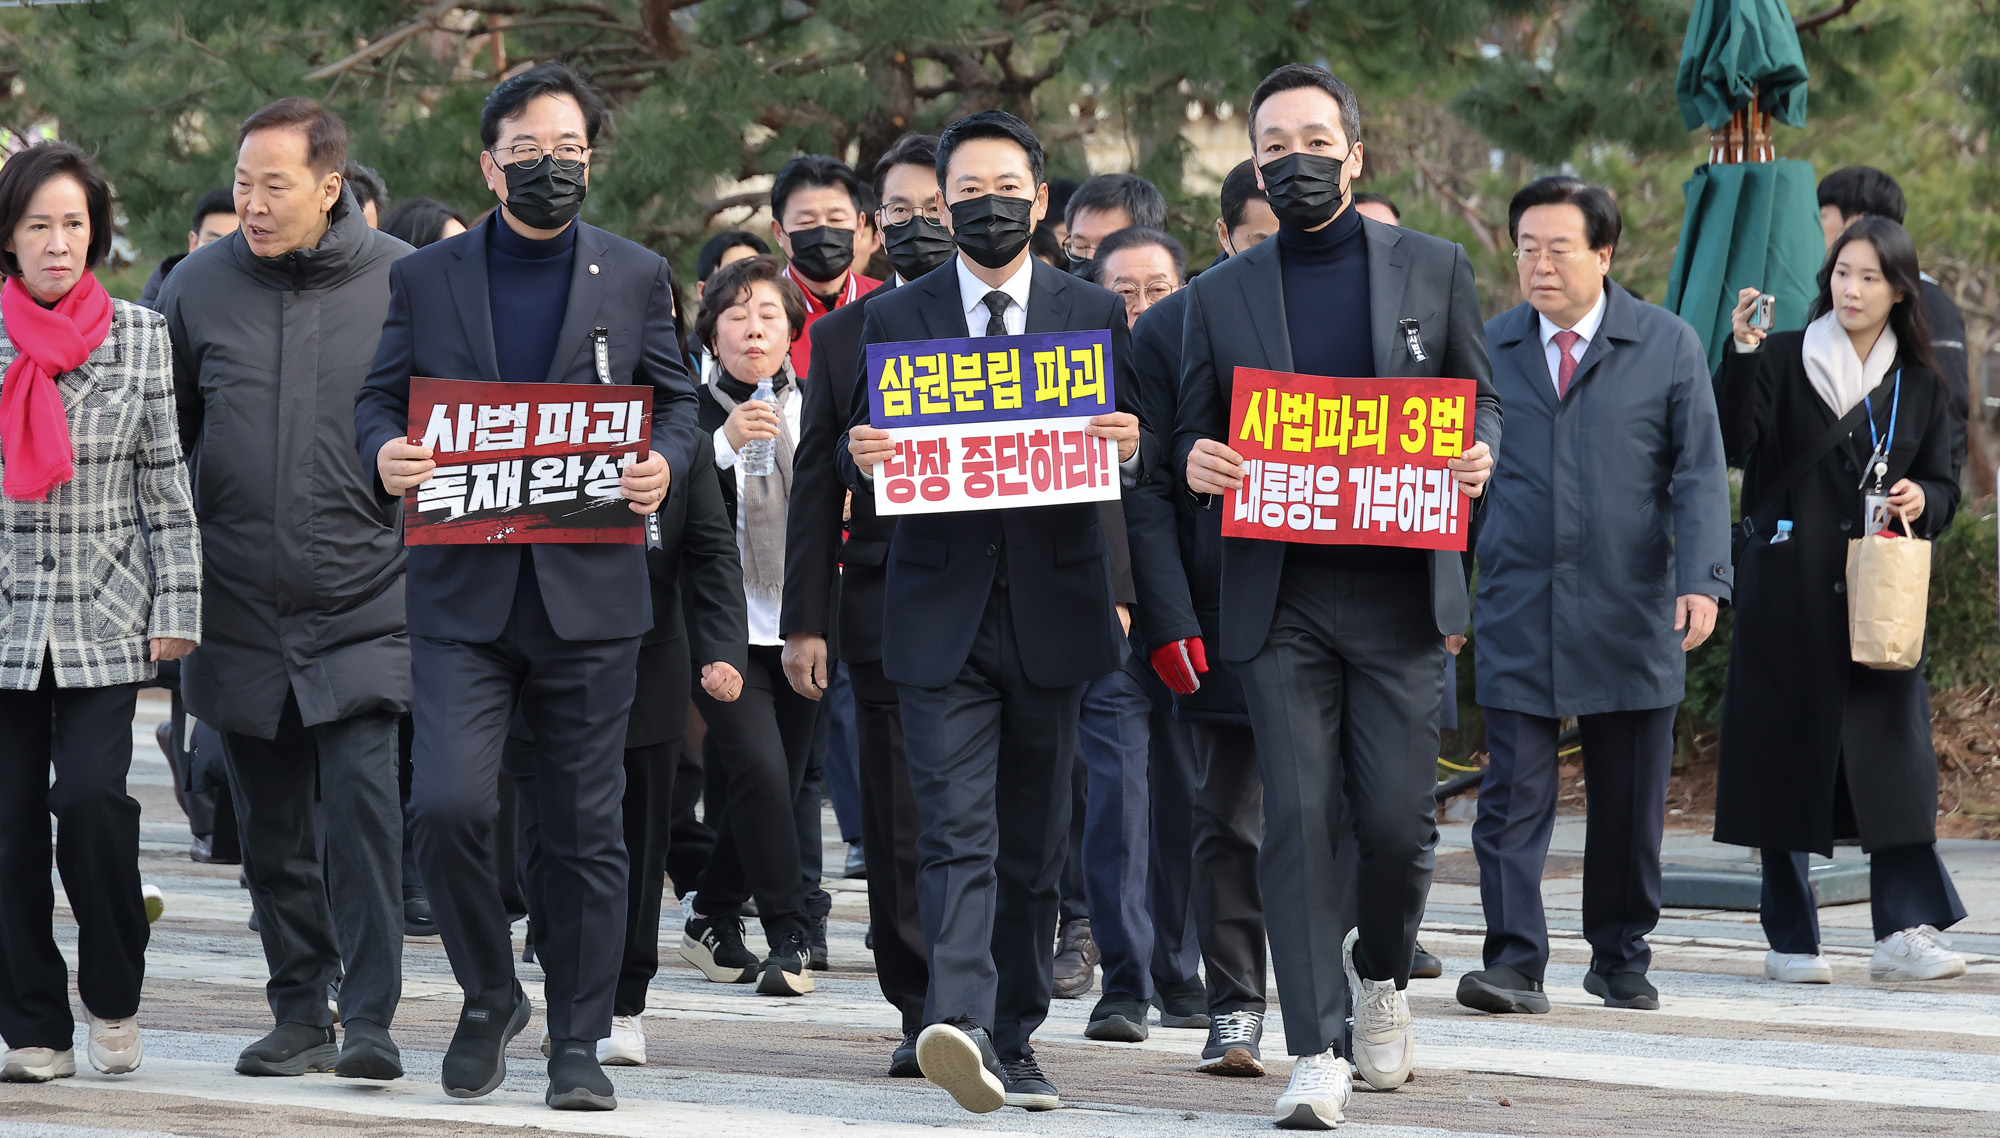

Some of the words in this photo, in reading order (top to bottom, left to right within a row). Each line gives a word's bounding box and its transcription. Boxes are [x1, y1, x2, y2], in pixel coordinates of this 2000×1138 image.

[878, 348, 1022, 416] 삼권분립
[1033, 343, 1106, 407] 파괴
[421, 402, 530, 453] 사법
[534, 400, 645, 446] 파괴
[1239, 388, 1389, 456] 사법파괴
[1400, 395, 1465, 458] 3법
[417, 459, 523, 518] 독재
[529, 451, 638, 505] 완성
[884, 437, 950, 504] 당장
[961, 429, 1110, 499] 중단하라!
[1234, 458, 1341, 531] 대통령은
[1348, 463, 1459, 534] 거부하라!
